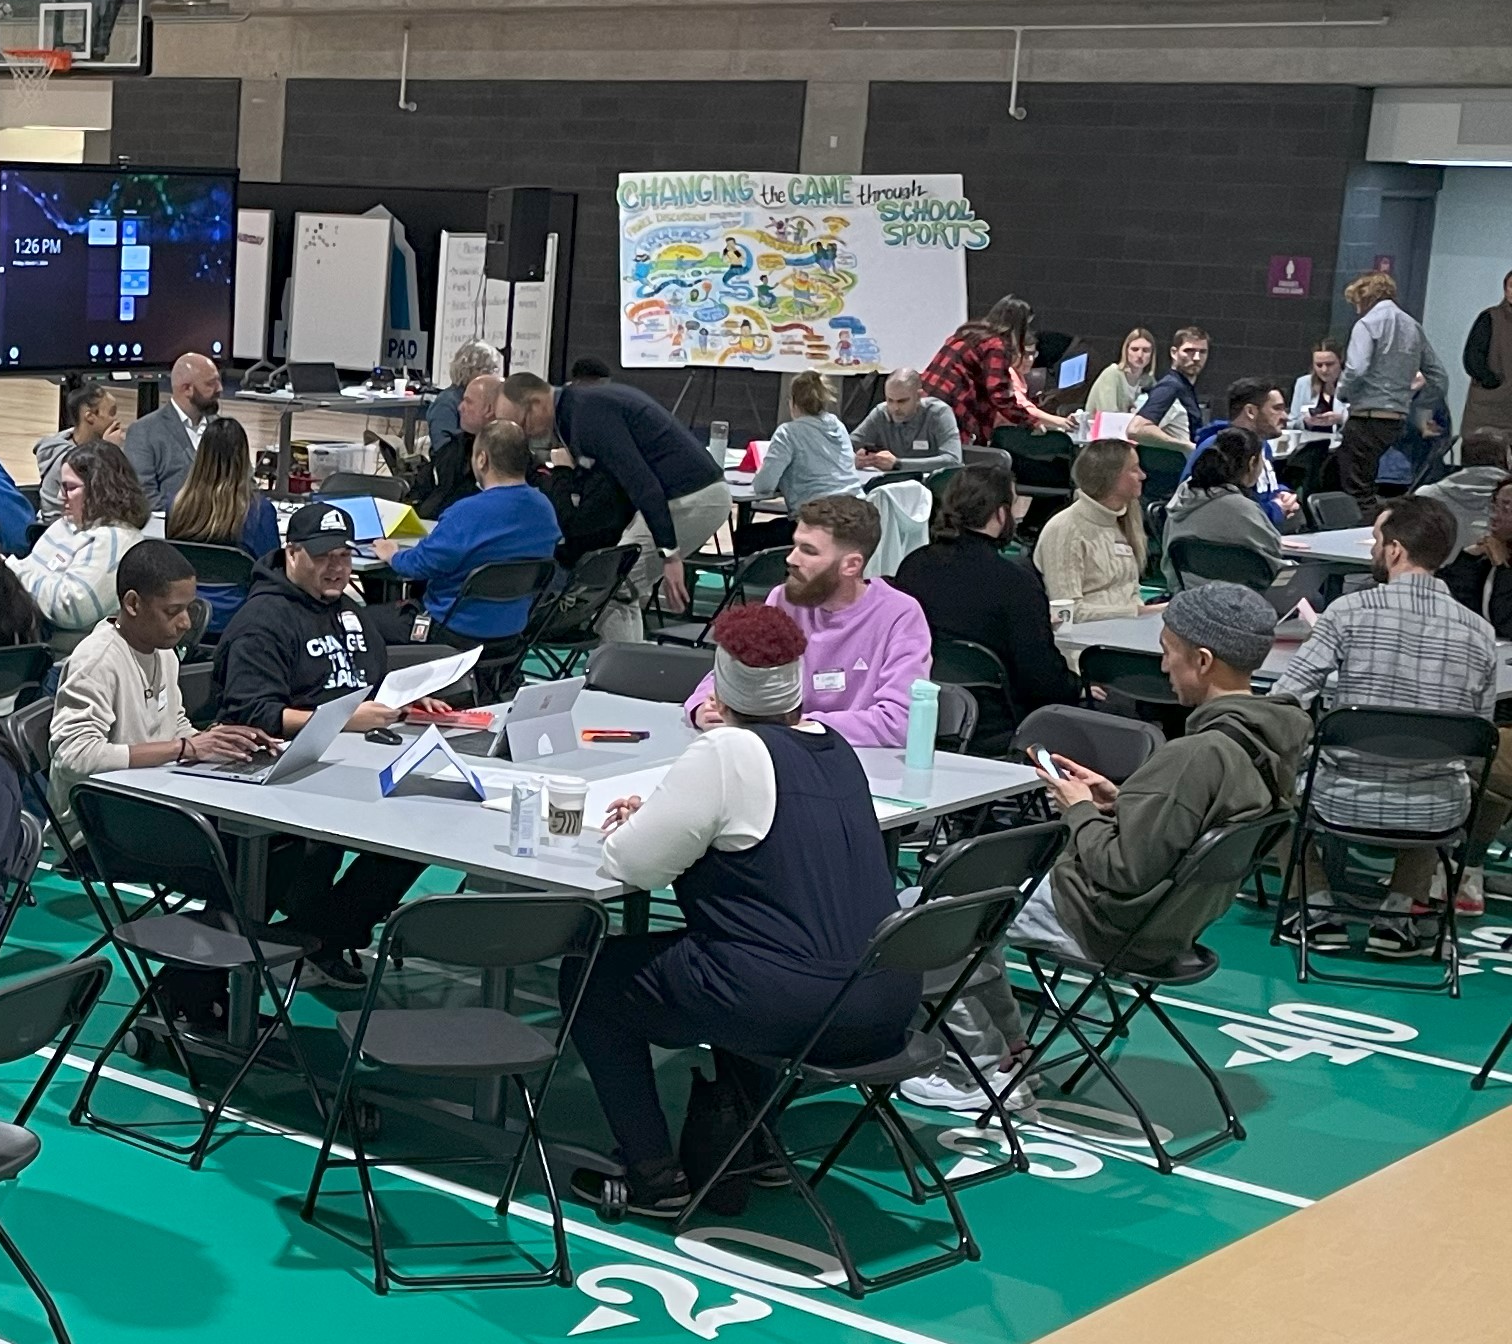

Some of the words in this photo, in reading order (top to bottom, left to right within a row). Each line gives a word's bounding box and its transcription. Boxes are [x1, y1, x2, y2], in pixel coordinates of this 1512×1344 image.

[619, 174, 754, 208] CHANGING
[760, 184, 786, 205] the
[788, 175, 854, 205] GAME
[857, 180, 928, 205] through
[877, 199, 974, 222] SCHOOL
[14, 238, 40, 255] 1:26
[42, 239, 61, 254] PM
[883, 222, 989, 250] SPORTS
[306, 633, 367, 657] CAGE
[1218, 1002, 1419, 1066] 40
[937, 1099, 1175, 1179] 30
[575, 1227, 849, 1340] 20
